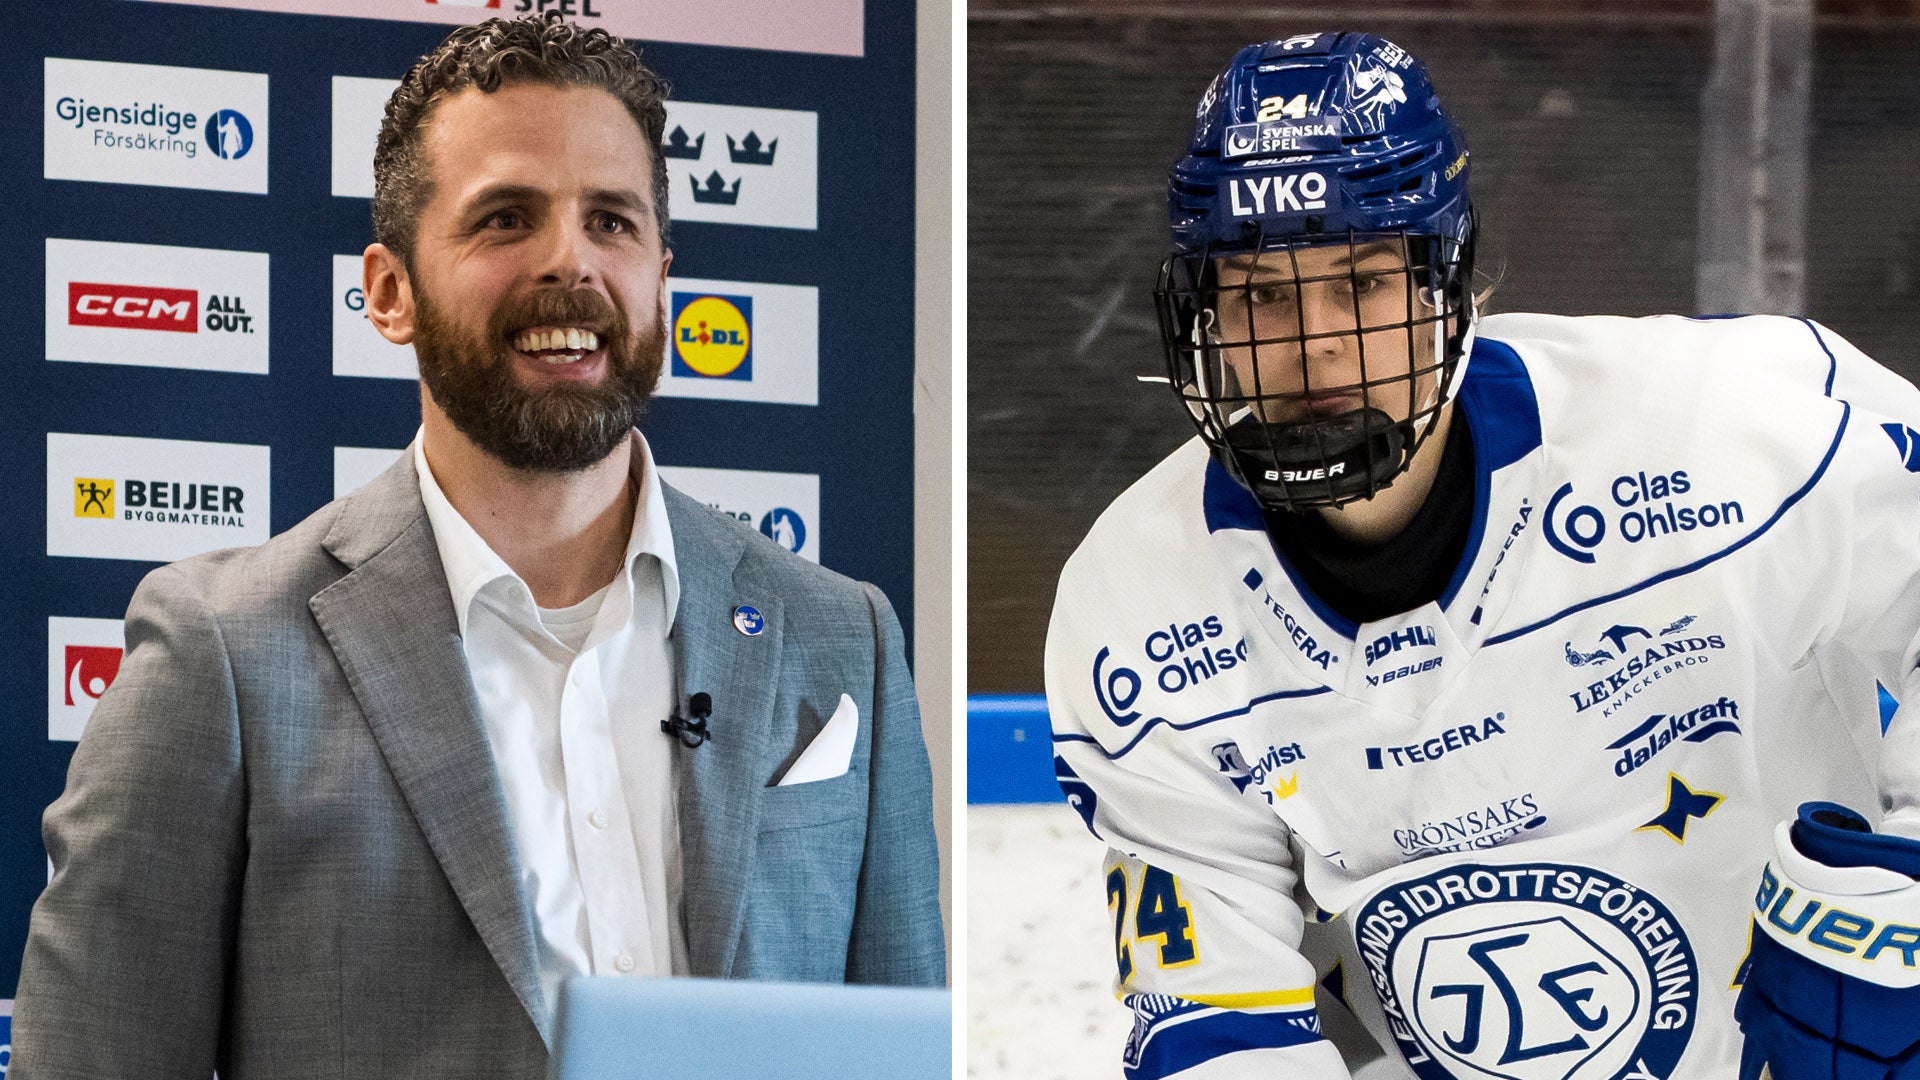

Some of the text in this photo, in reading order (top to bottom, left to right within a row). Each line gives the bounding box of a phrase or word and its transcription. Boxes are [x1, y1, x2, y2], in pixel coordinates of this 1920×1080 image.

[56, 97, 197, 135] Gjensidige
[1257, 94, 1308, 123] 24
[94, 129, 197, 158] Försäkring
[1262, 124, 1336, 140] SVENSKA
[1262, 138, 1301, 152] SPEL
[1229, 172, 1327, 216] LYKO
[75, 295, 191, 320] CCM
[206, 294, 246, 314] ALL
[206, 314, 254, 334] OUT.
[1264, 462, 1345, 482] BAUER
[1611, 470, 1691, 507] Clas
[124, 479, 245, 514] BEIJER
[124, 510, 245, 528] BYGGMATERIAL
[1619, 500, 1744, 543] Ohlson
[1145, 615, 1223, 663] Clas
[1570, 635, 1726, 713] LEKSANDS
[1602, 655, 1709, 718] KNÄCKEBRÖD
[1614, 697, 1740, 778] dalakraft
[1393, 793, 1539, 850] GRÖNSAKS
[1106, 862, 1201, 986] 24
[1399, 868, 1691, 1031] IDROTTSFÖRENING
